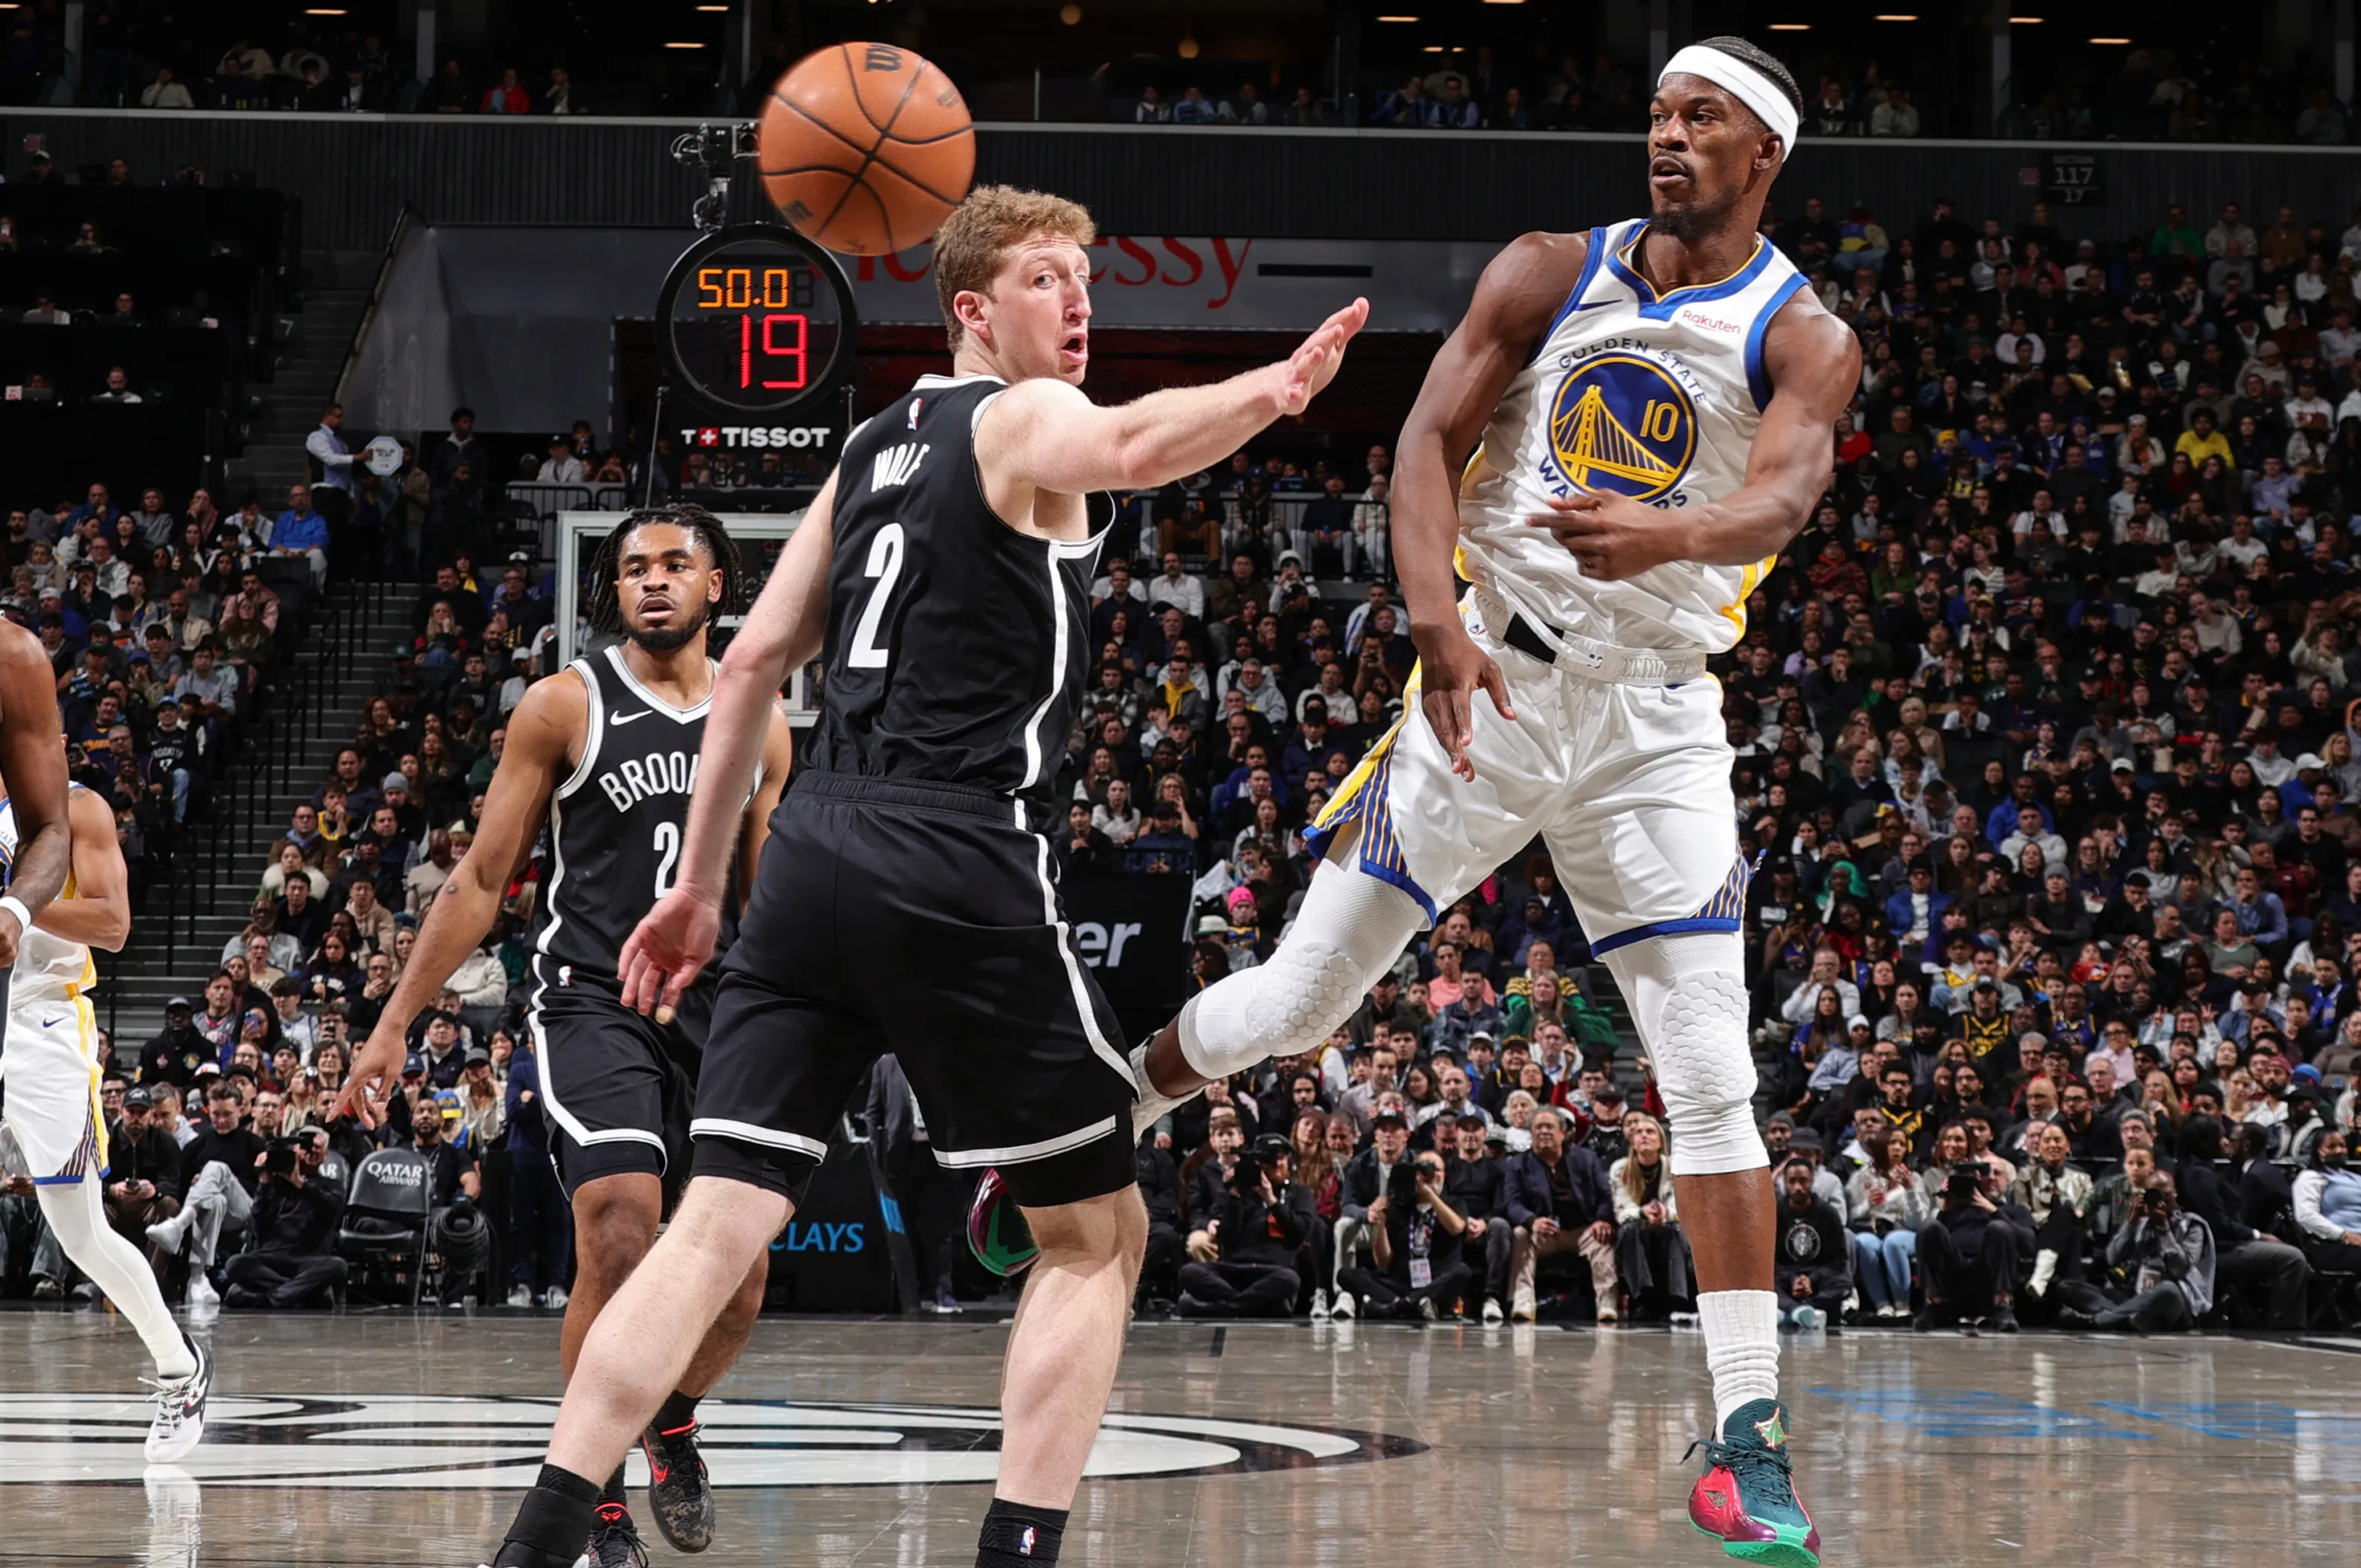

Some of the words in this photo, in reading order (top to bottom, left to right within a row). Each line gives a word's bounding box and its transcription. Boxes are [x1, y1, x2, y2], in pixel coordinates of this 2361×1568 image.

[2055, 167, 2094, 184] 117
[2063, 189, 2084, 203] 17
[698, 268, 789, 308] 50.0
[1682, 309, 1741, 335] Rakuten
[741, 314, 808, 389] 19
[1559, 338, 1649, 369] GOLDEN
[1658, 350, 1707, 404] STATE
[721, 427, 830, 448] TISSOT
[1640, 399, 1679, 442] 10
[871, 442, 931, 493] WOLF
[848, 522, 905, 668] 2
[653, 822, 680, 899] 2
[367, 1161, 423, 1179] QATAR
[379, 1175, 421, 1187] AIRWAYS
